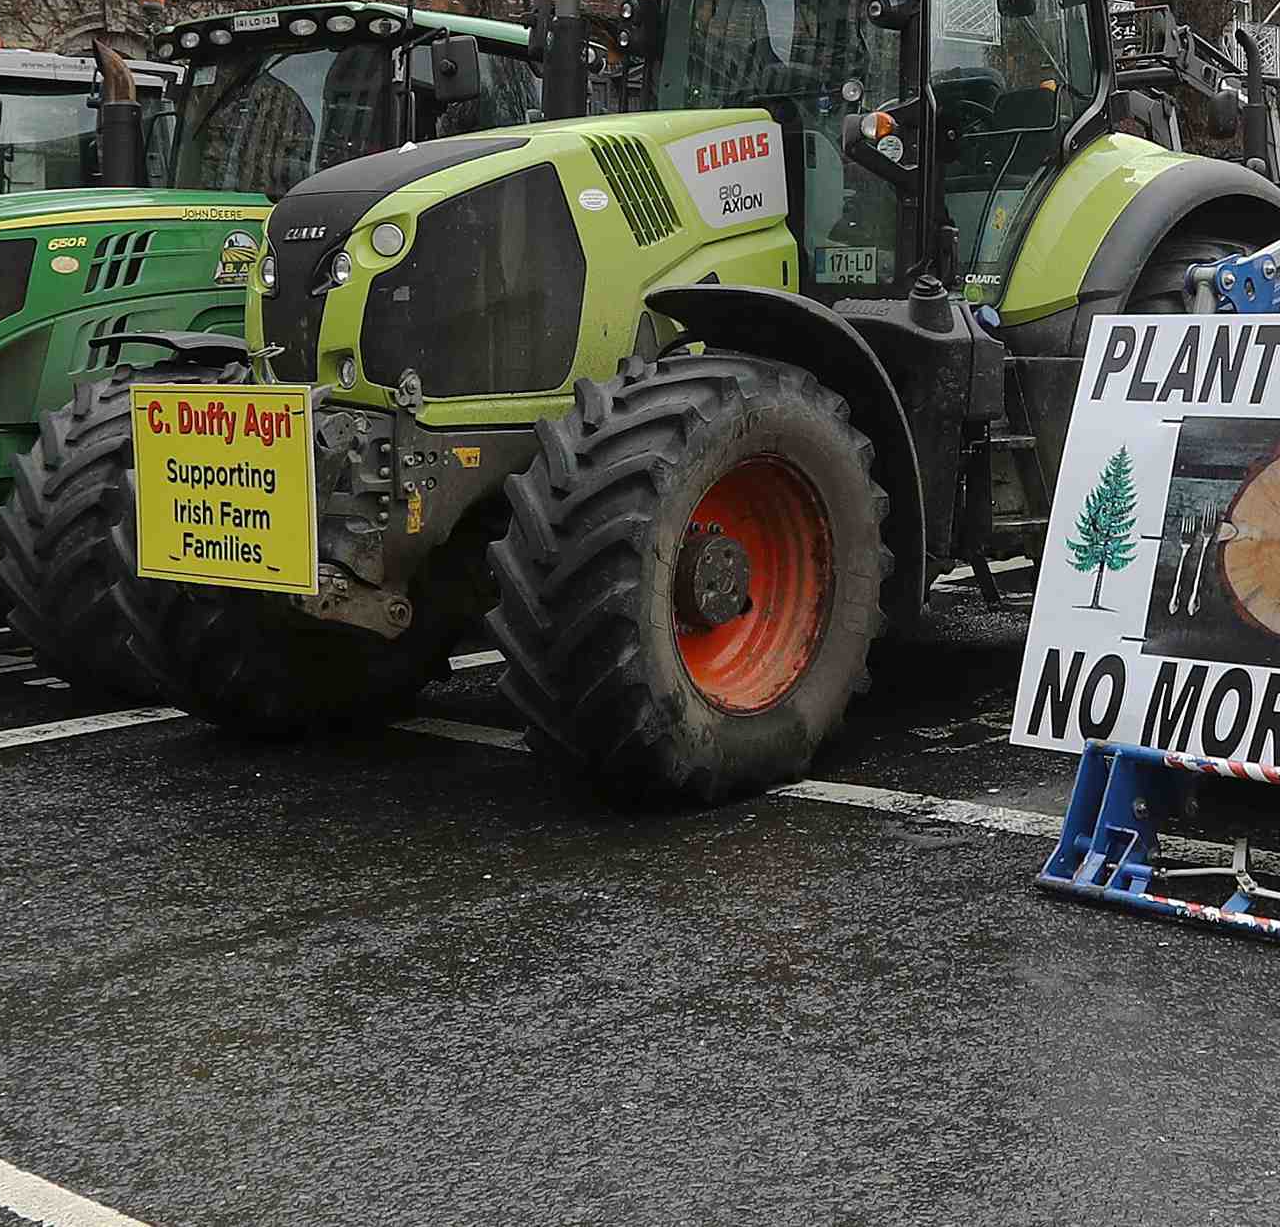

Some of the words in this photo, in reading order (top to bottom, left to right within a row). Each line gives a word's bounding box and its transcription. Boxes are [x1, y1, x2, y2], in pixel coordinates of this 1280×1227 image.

[696, 132, 769, 174] CLAAS
[719, 183, 742, 200] BIO
[722, 192, 762, 215] AXION
[182, 208, 209, 220] JOHN
[210, 208, 243, 220] DEERE
[965, 274, 1001, 285] CMATIC
[147, 401, 171, 433] C.
[178, 401, 236, 445] Duffy
[244, 403, 292, 447] Agri
[166, 457, 276, 494] Supporting
[174, 498, 213, 525] Irish
[220, 501, 270, 530] Farm
[183, 532, 262, 564] Families
[1027, 648, 1126, 740] NO
